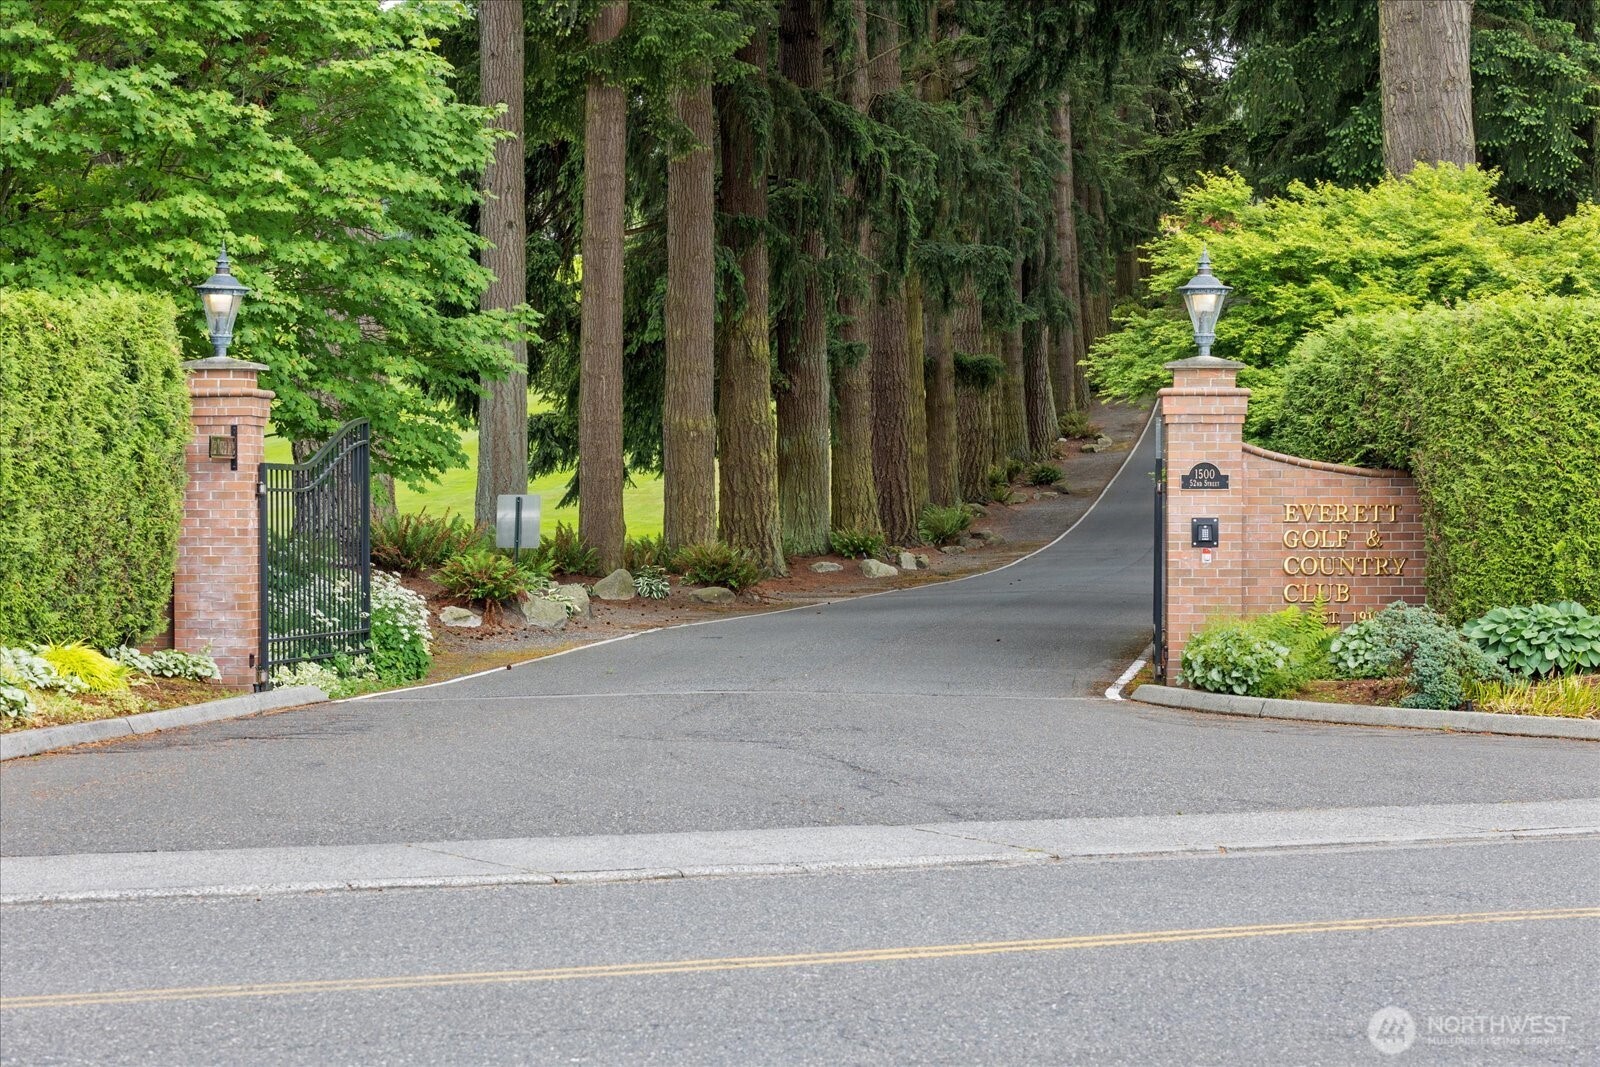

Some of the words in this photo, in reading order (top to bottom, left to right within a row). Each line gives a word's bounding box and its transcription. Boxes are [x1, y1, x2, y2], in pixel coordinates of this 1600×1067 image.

[1195, 469, 1215, 479] 1500
[1283, 503, 1402, 523] EVERETT
[1283, 529, 1350, 549] GOLF
[1365, 529, 1383, 549] &
[1283, 556, 1407, 576] COUNTRY
[1283, 583, 1350, 603] CLUB
[1313, 611, 1340, 624] ST.
[1352, 611, 1377, 624] 191
